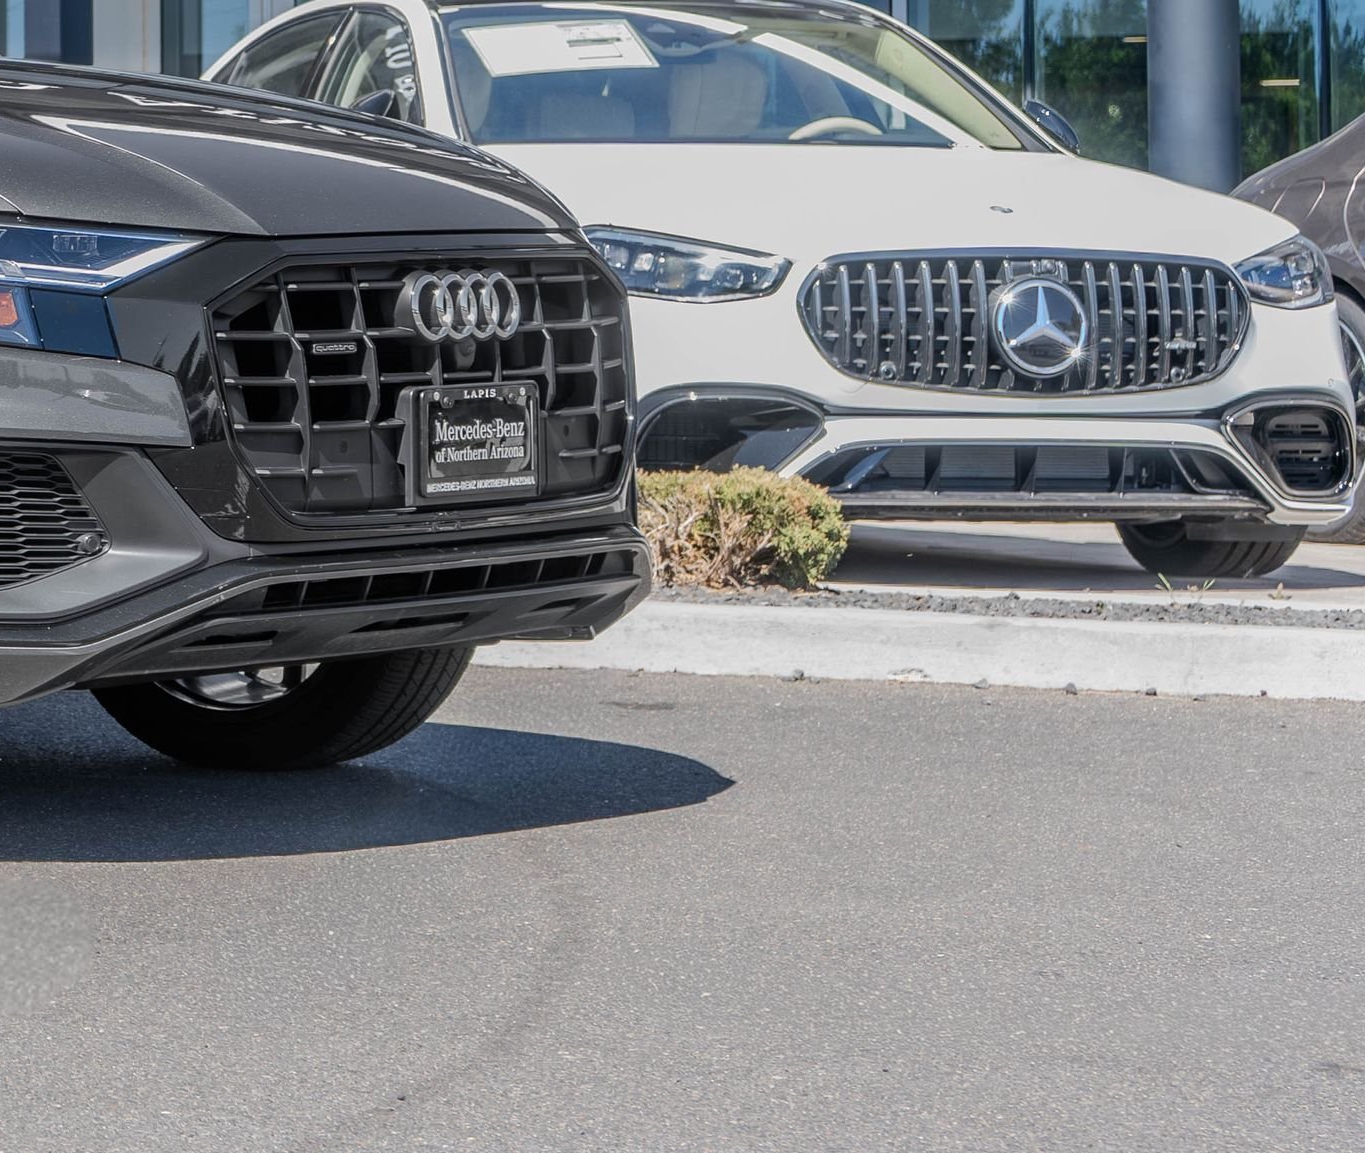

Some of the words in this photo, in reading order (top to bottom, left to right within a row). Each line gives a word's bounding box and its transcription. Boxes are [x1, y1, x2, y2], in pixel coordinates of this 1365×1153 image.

[463, 388, 497, 399] LAPIS
[435, 418, 525, 442] Mercedes-Benz
[435, 447, 447, 463] of
[447, 445, 489, 462] Northern
[489, 444, 525, 459] Arizona
